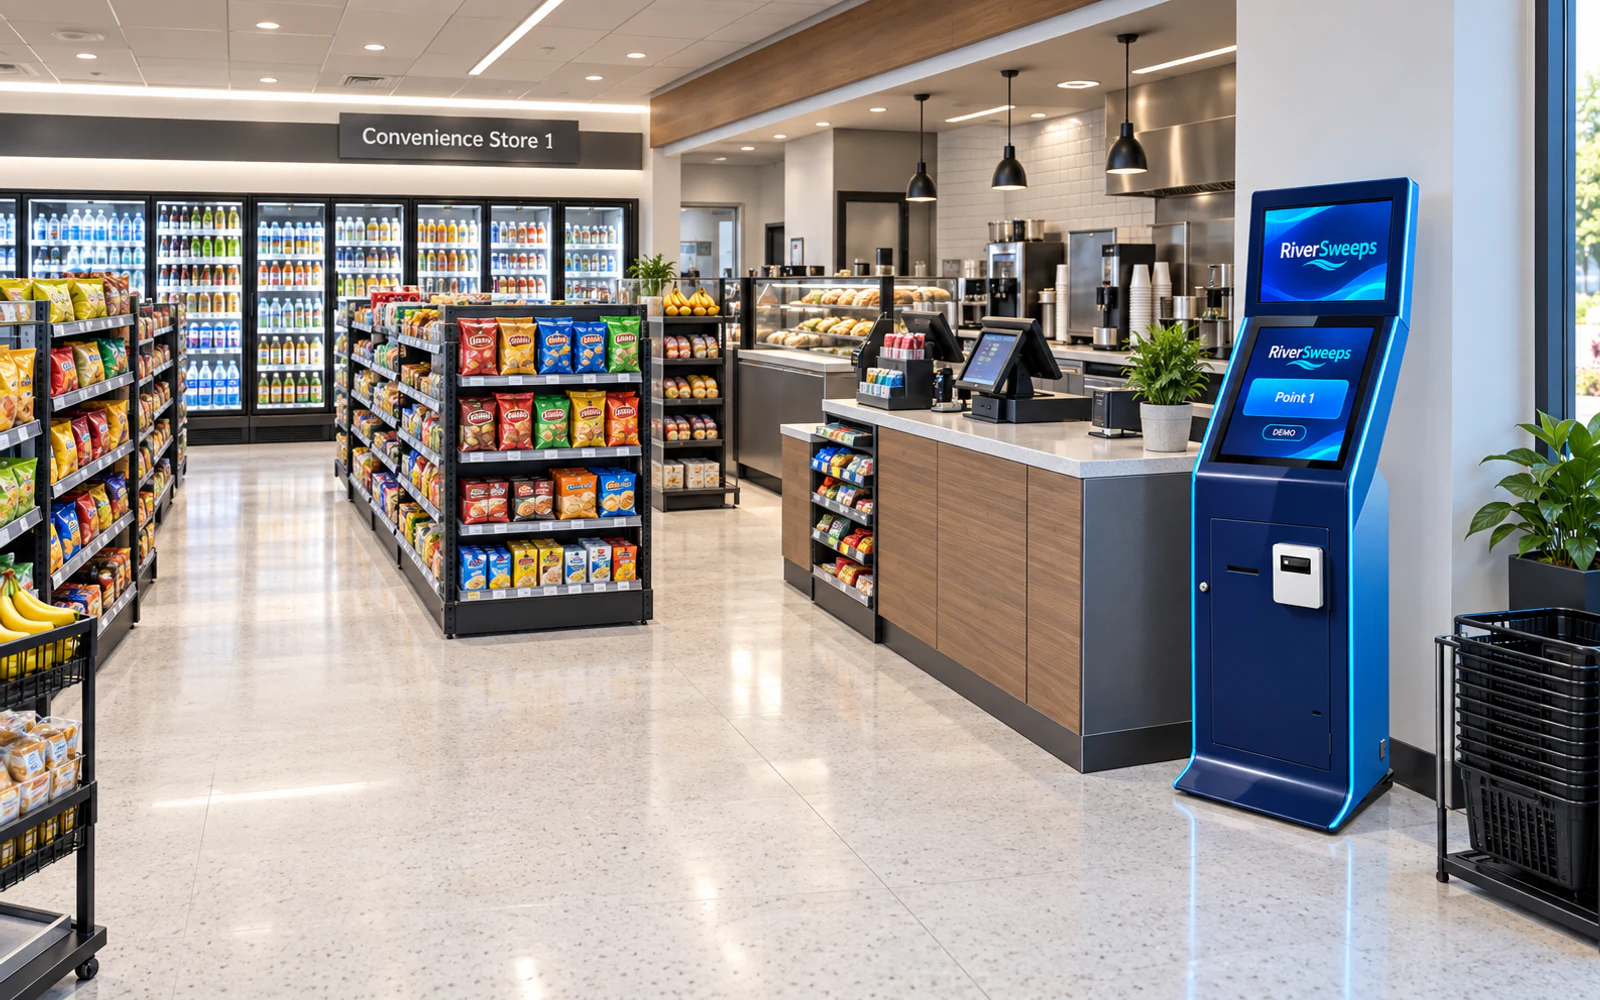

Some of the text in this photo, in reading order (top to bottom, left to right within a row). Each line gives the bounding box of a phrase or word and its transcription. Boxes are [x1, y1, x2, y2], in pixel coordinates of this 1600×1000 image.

[362, 127, 553, 149] Convenience Store 1
[1280, 240, 1378, 260] RiverSweeps
[1268, 345, 1352, 363] RiverSweeps
[1274, 391, 1315, 404] Point 1
[1272, 428, 1296, 437] DEMO
